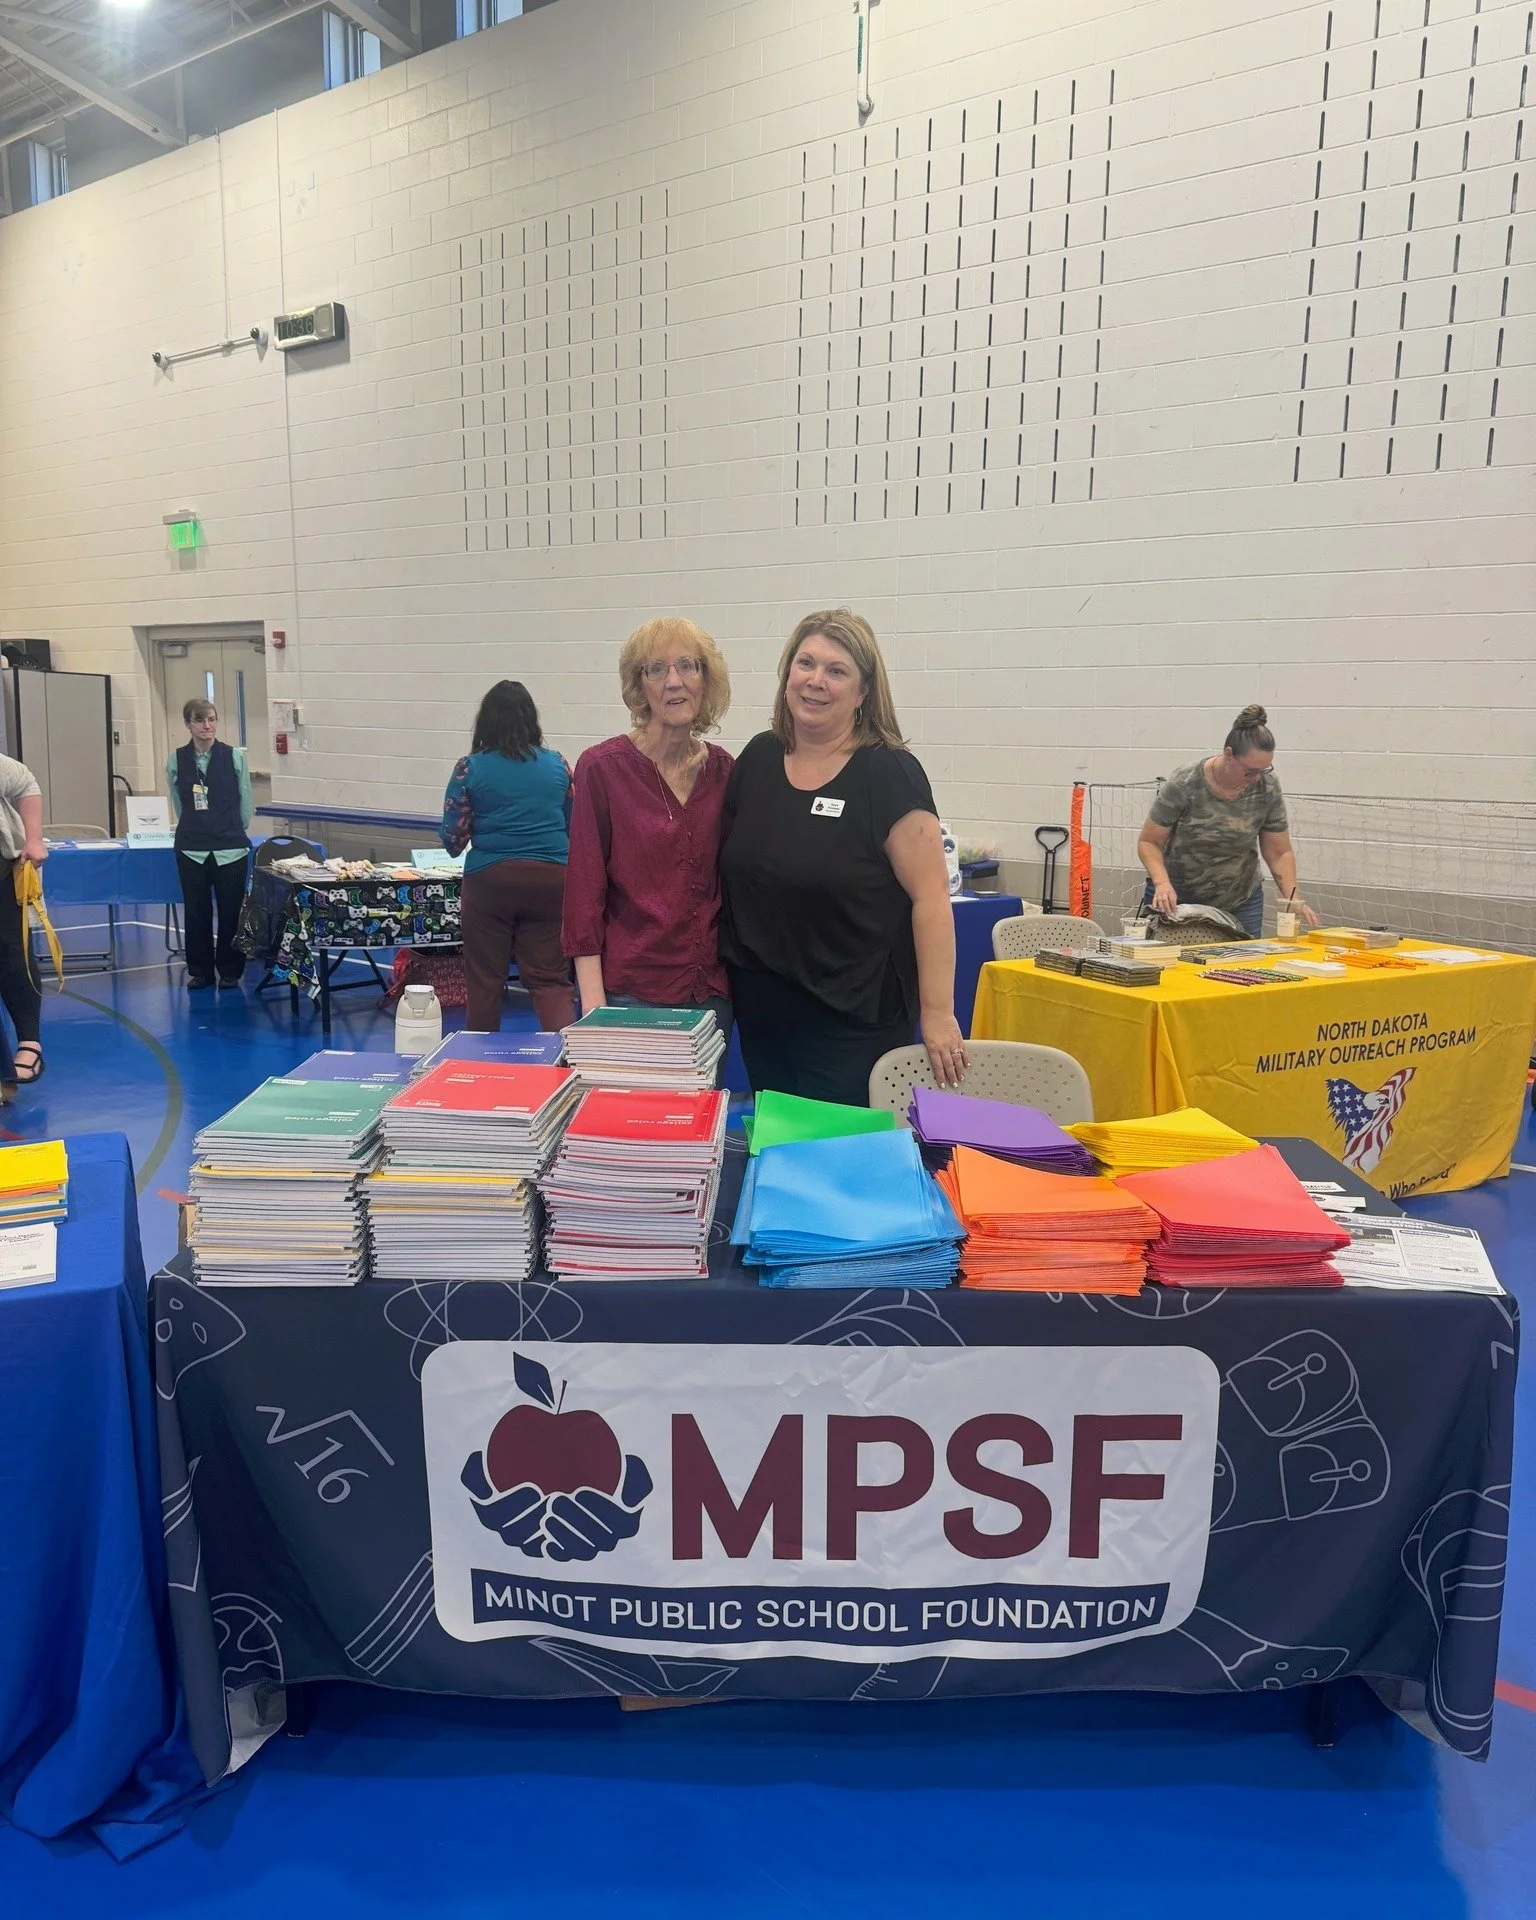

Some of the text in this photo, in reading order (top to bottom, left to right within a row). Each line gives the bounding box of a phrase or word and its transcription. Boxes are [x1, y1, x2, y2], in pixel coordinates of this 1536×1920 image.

[1080, 875, 1090, 919] OWNET
[1256, 1026, 1476, 1074] MILITARY OUTREACH PROGRAM
[1317, 1012, 1428, 1042] NORTH DAKOTA
[1389, 1181, 1416, 1200] Who
[671, 1413, 1183, 1560] MPSF
[484, 1581, 1158, 1633] MINOT PUBLIC SCHOOL FOUNDATION
